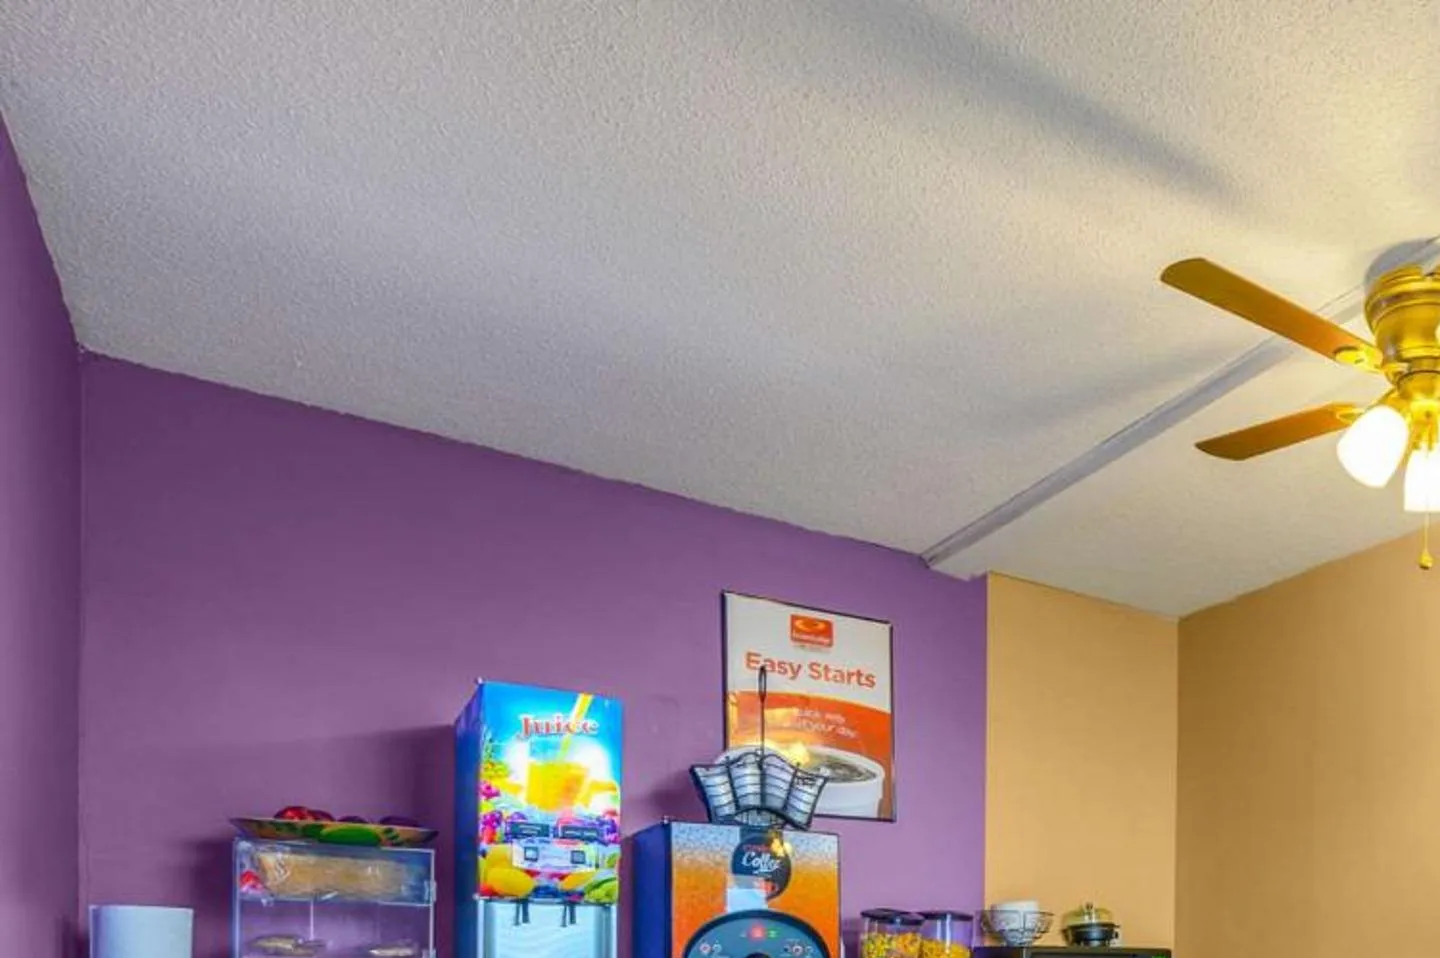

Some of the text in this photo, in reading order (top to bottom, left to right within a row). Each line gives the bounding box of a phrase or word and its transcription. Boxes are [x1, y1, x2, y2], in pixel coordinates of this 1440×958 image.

[746, 652, 877, 688] Easy Starts
[516, 714, 599, 739] Juice
